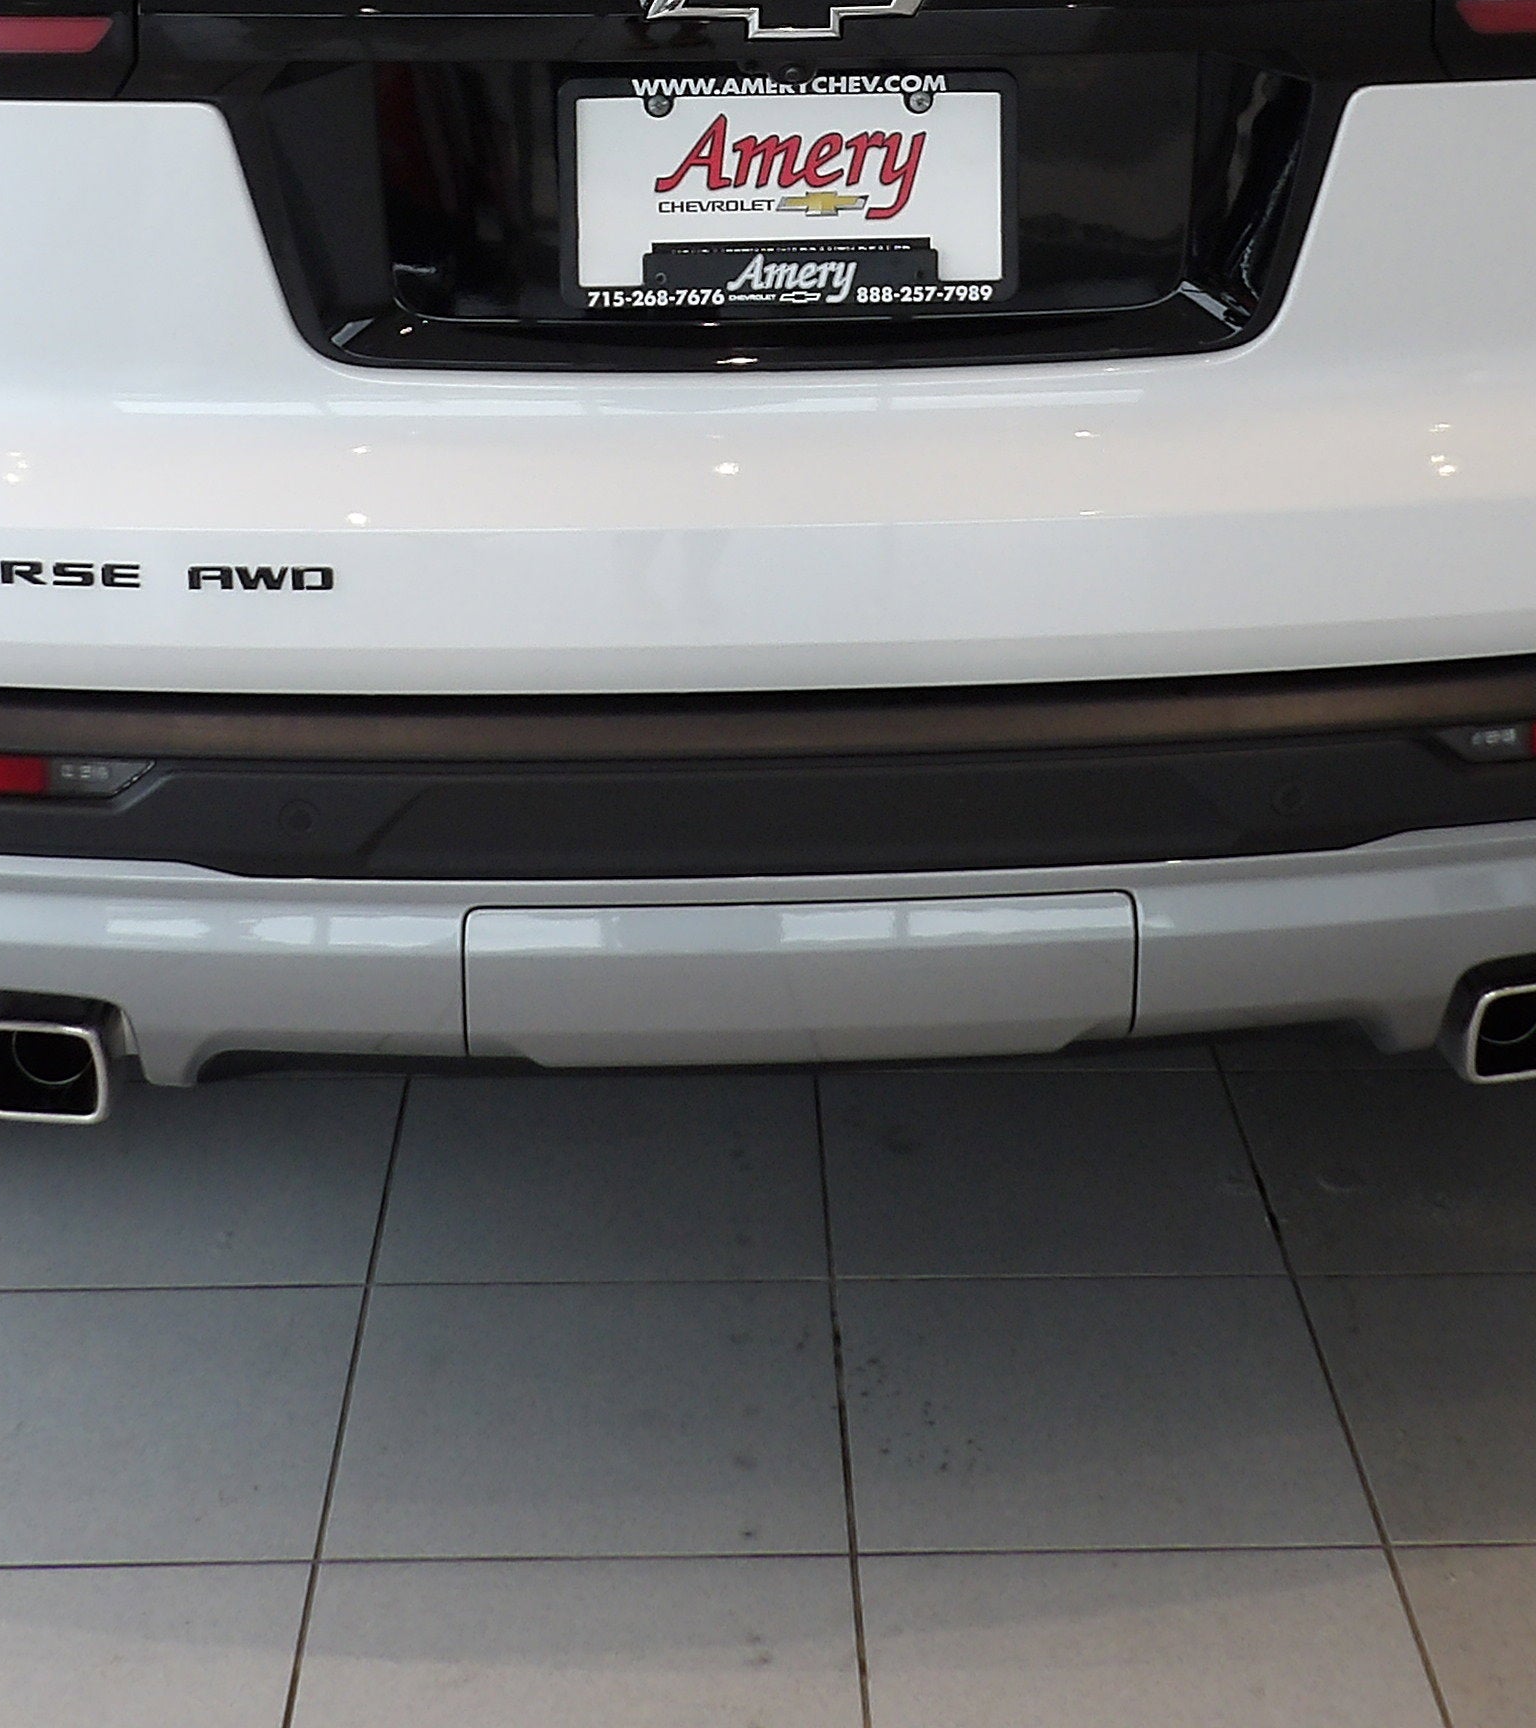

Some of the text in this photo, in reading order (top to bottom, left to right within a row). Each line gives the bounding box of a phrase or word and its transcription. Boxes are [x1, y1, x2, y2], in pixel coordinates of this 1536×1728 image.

[654, 113, 927, 220] Amery
[657, 198, 776, 214] CHEVROLET
[726, 253, 858, 303] Amery
[587, 288, 725, 308] 715-268-7676
[728, 293, 777, 302] CHEVROLET
[856, 285, 993, 303] 888-257-7989
[187, 565, 335, 591] AWD
